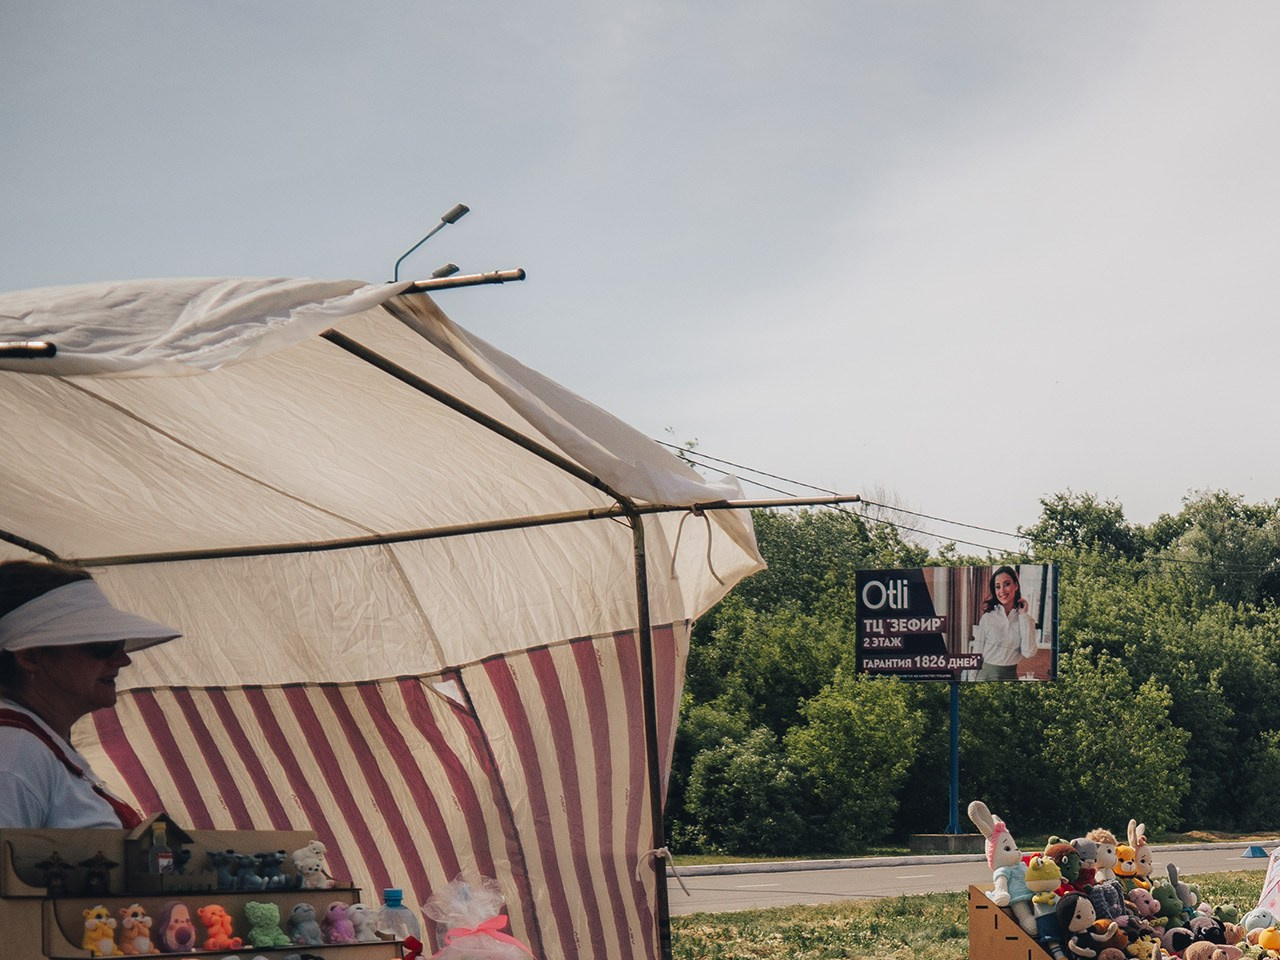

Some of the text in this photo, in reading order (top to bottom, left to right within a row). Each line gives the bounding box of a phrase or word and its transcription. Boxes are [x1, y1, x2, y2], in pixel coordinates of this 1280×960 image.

[862, 580, 908, 609] Otli
[864, 619, 884, 634] ТЦ
[863, 638, 902, 647] 2 ЭТАЖ
[863, 659, 912, 668] ГАРАНТИЯ
[914, 655, 945, 668] 1826
